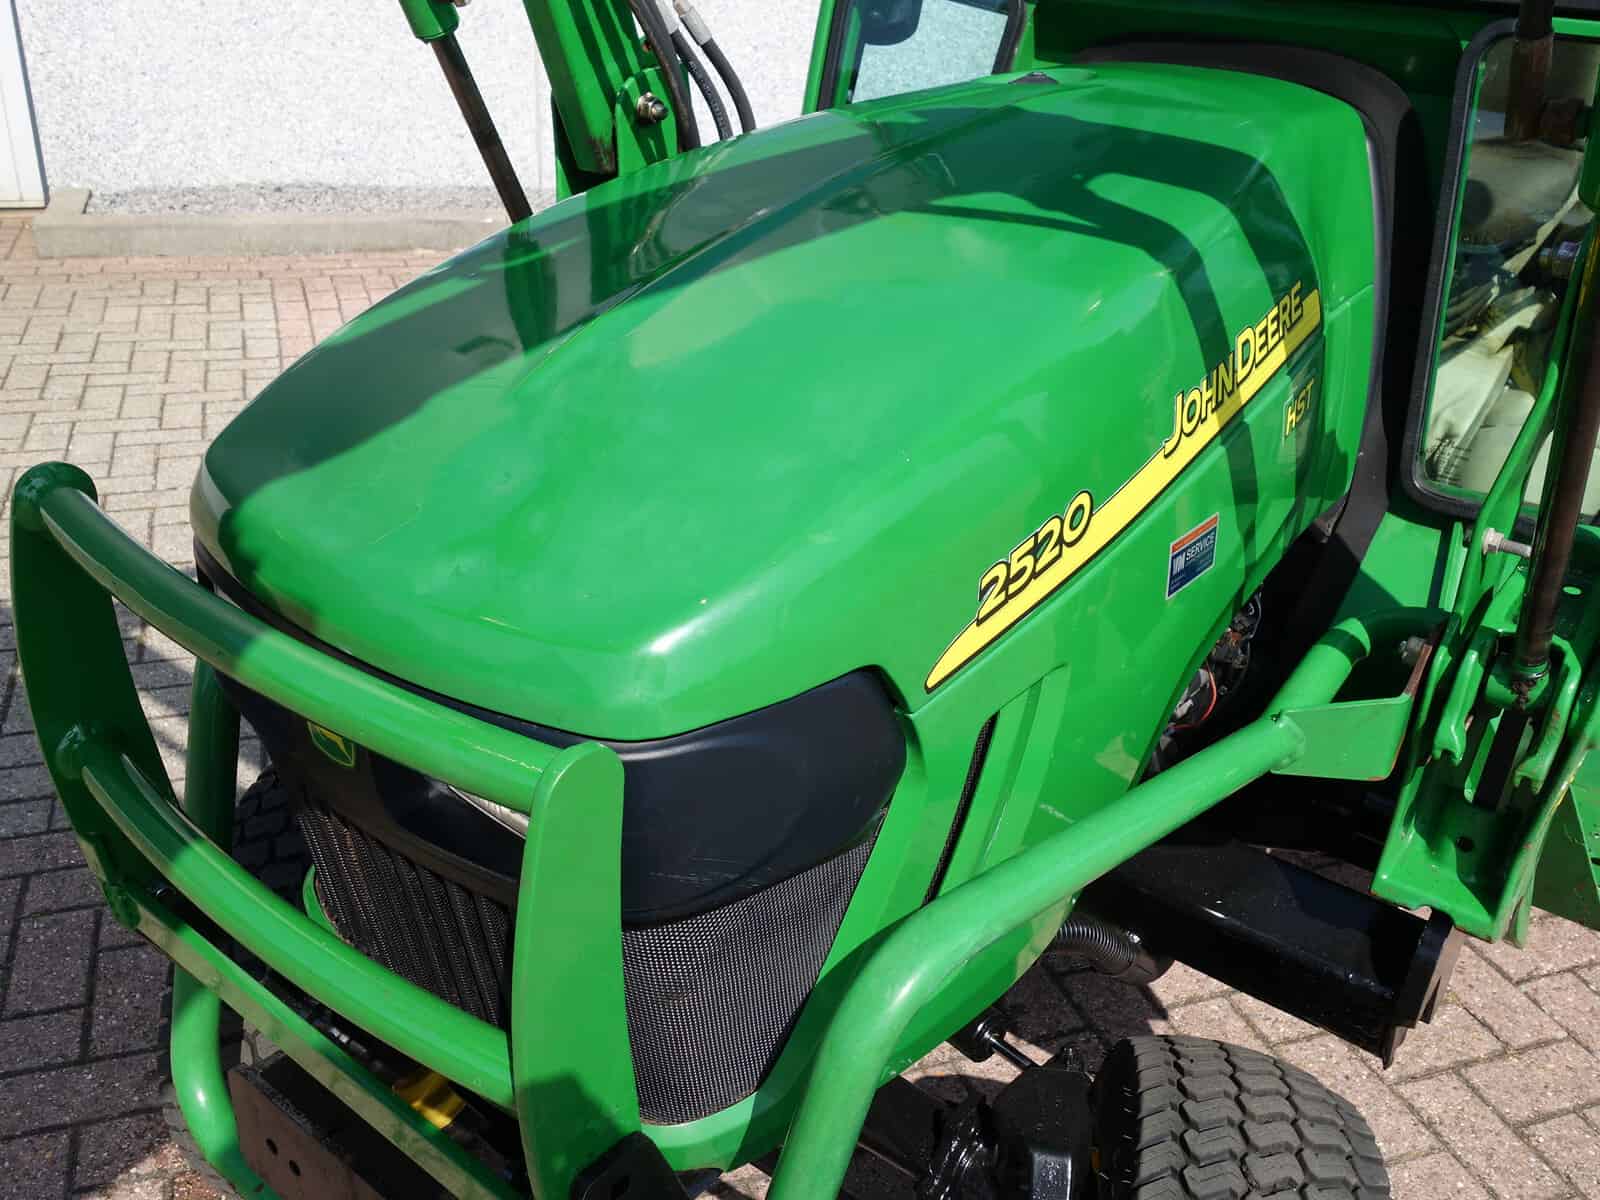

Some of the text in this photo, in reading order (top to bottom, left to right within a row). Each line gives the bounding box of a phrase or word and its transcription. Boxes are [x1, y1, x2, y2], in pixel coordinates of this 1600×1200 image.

[1163, 280, 1303, 458] JOHN DEERE
[1285, 378, 1315, 436] HST
[976, 490, 1093, 626] 2520
[1186, 531, 1215, 561] SERVICE
